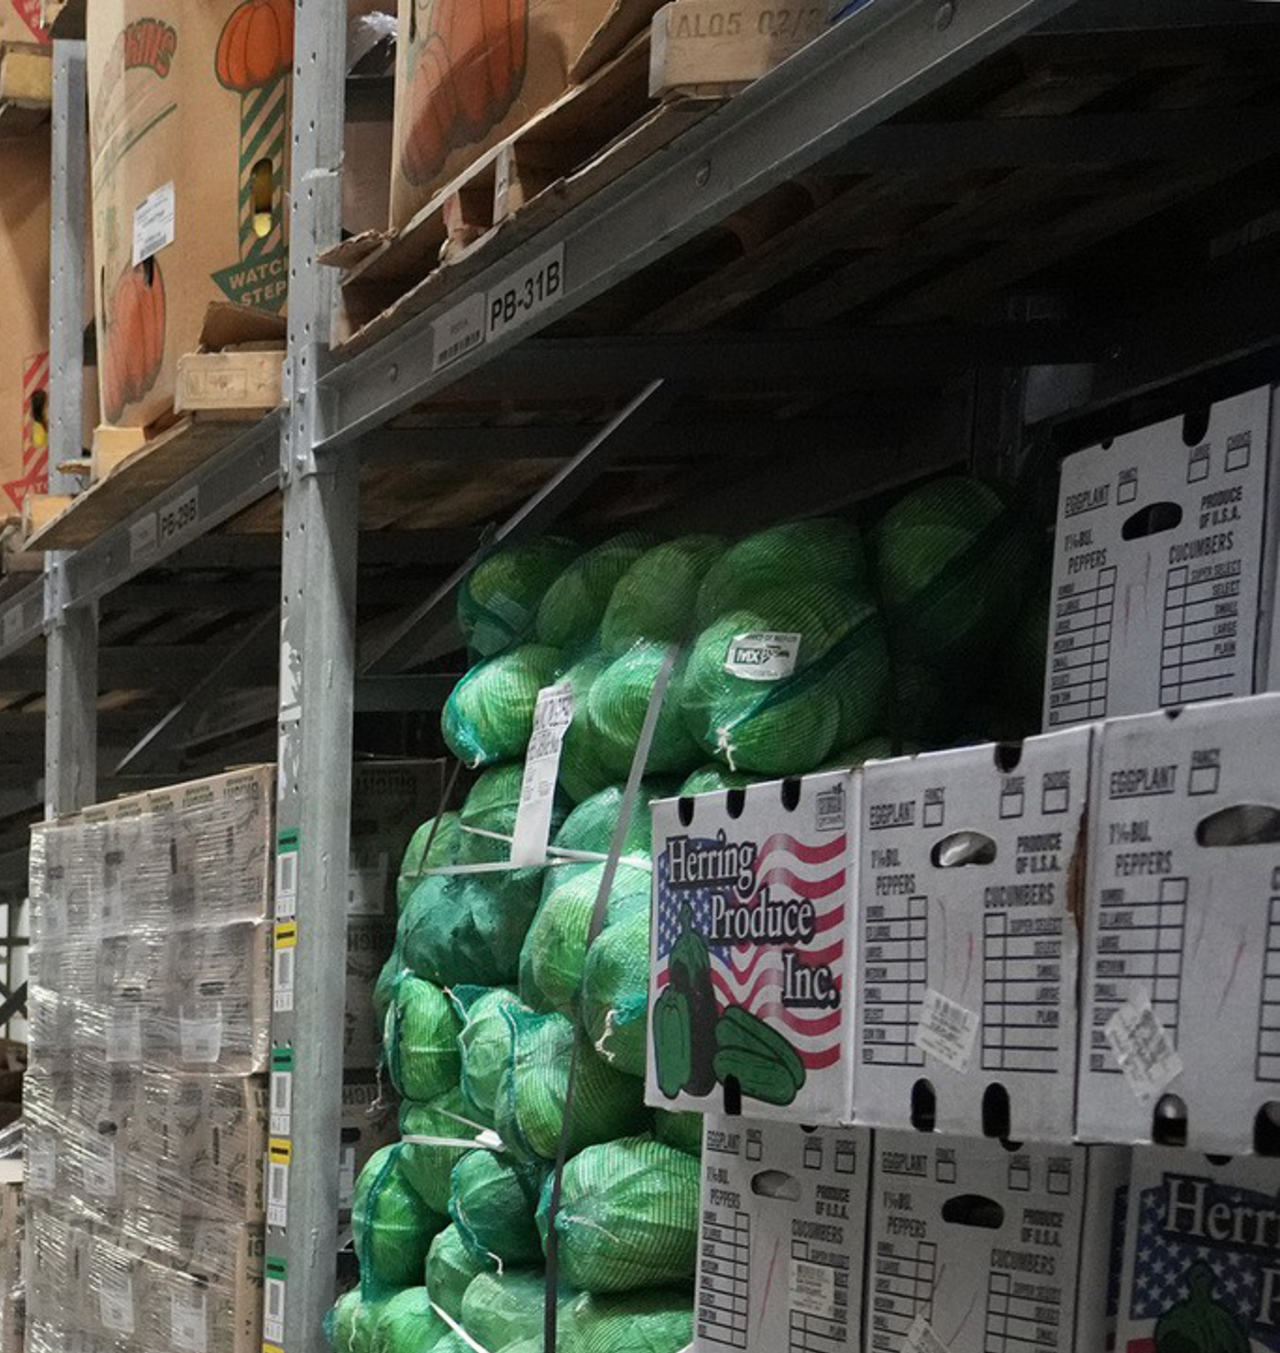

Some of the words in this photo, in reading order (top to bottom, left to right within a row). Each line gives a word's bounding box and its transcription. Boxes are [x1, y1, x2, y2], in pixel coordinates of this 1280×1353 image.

[490, 261, 561, 331] PB-31B
[1068, 549, 1107, 574] PEPPERS
[1169, 532, 1234, 565] CUCUMBERS
[1109, 765, 1178, 794] EGGPLANT
[666, 829, 757, 892] Herring
[1115, 851, 1173, 877] PEPPERS
[709, 885, 814, 942] Produce
[984, 882, 1055, 908] CUCUMBERS
[783, 951, 838, 1002] Inc.
[1162, 1178, 1280, 1251] Herr
